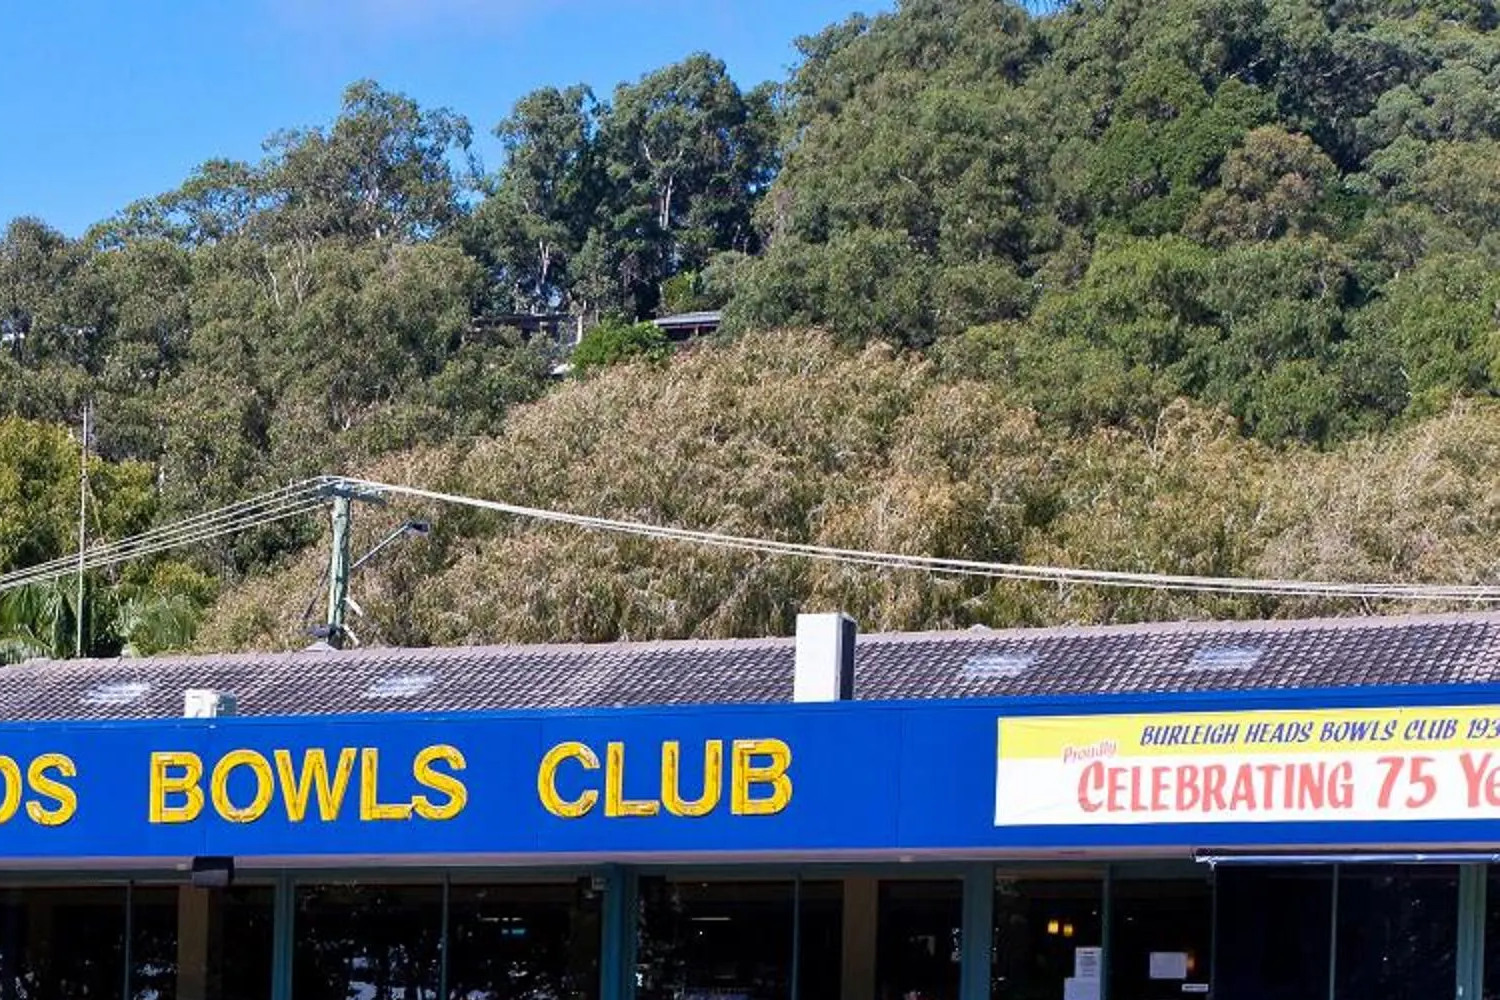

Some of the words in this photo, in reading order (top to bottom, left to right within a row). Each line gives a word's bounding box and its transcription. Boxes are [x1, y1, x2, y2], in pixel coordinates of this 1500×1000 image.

[1140, 724, 1240, 746] BURLEIGH
[1244, 721, 1314, 744] HEADS
[1319, 719, 1398, 743] BOWLS
[1403, 718, 1458, 741] CLUB
[148, 745, 467, 823] BOWLS
[537, 739, 793, 817] CLUB
[1077, 759, 1354, 813] CELEBRATING
[1376, 756, 1438, 809] 75
